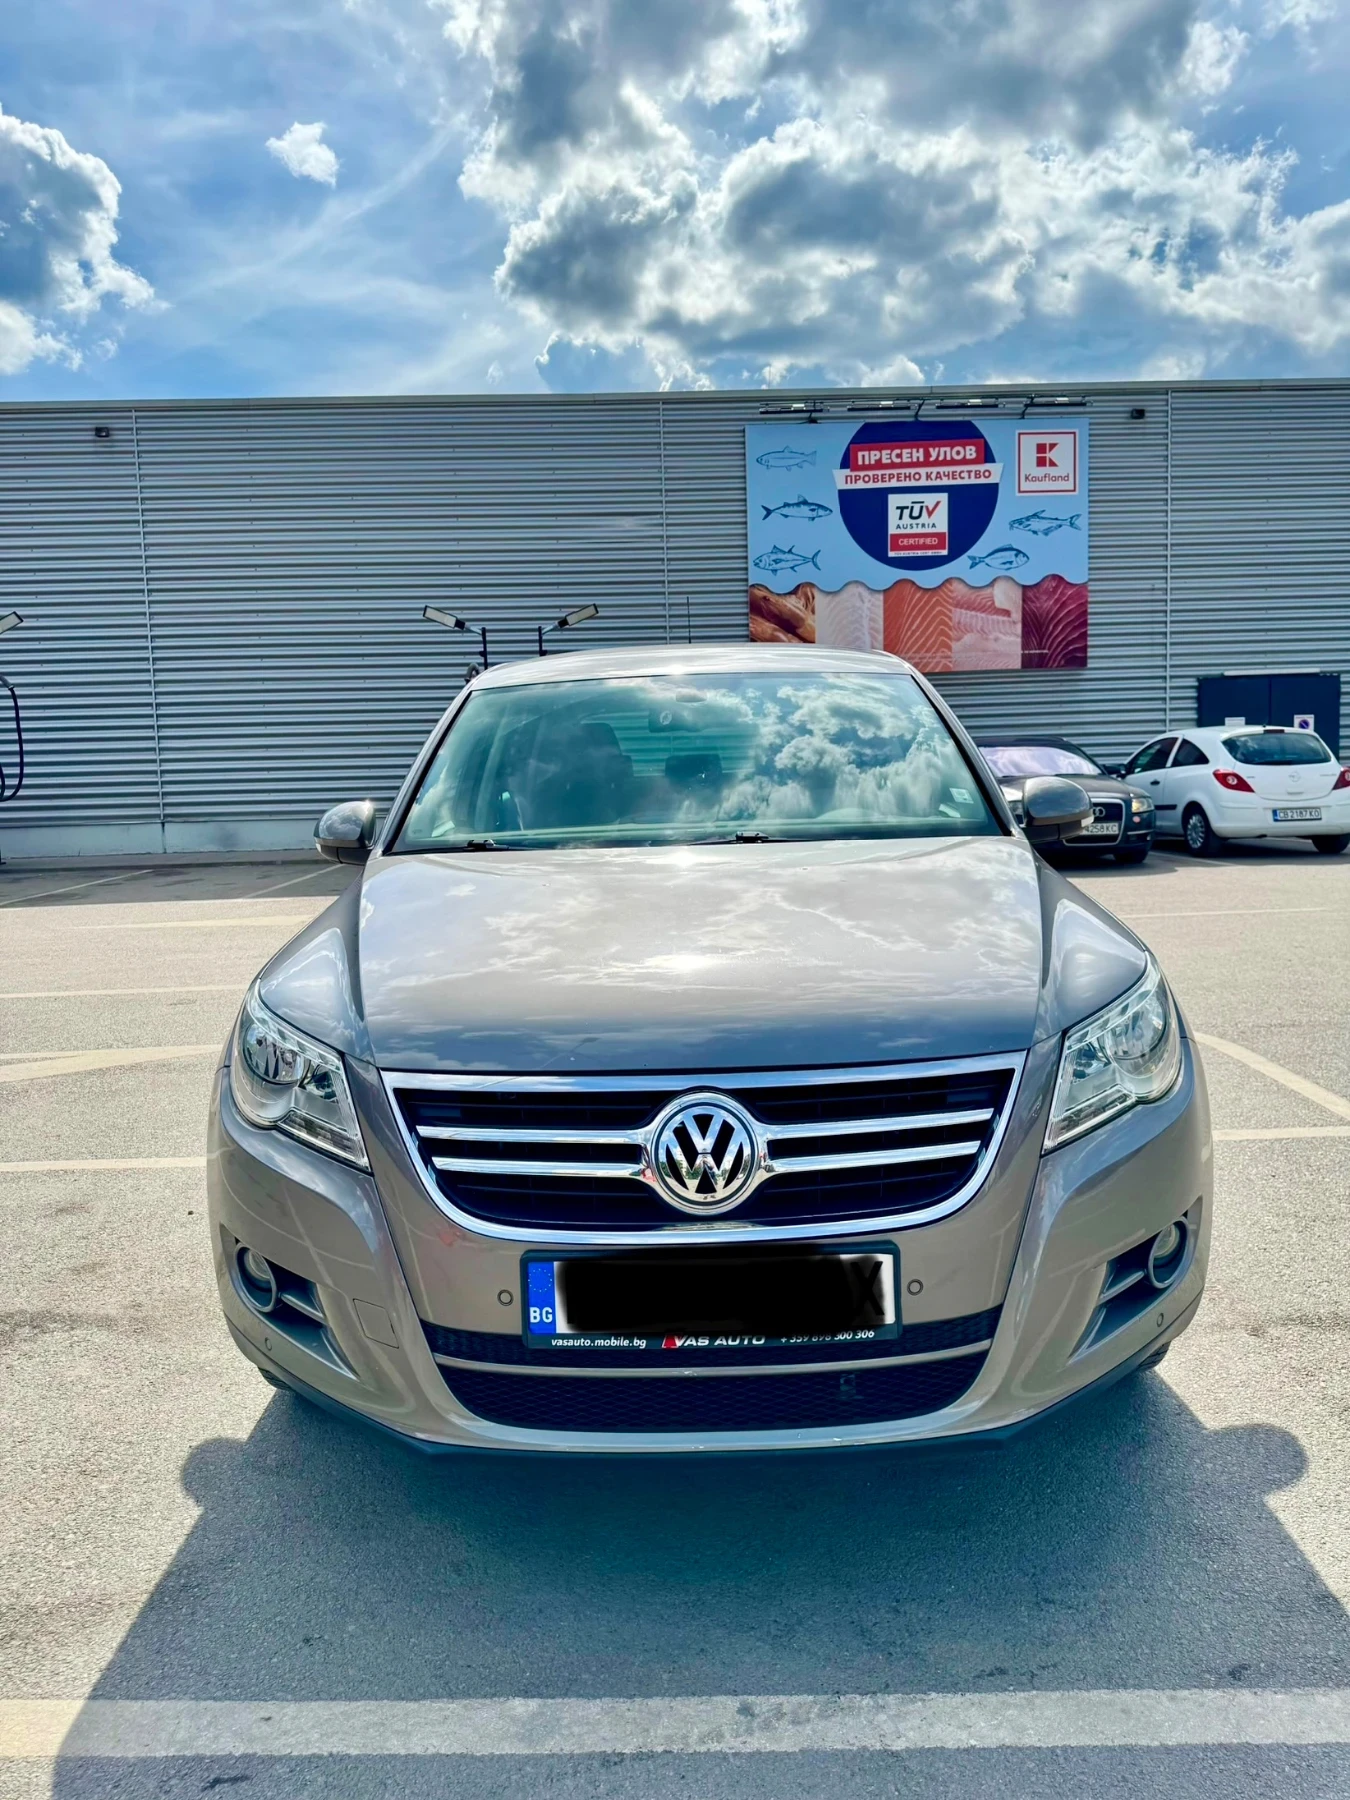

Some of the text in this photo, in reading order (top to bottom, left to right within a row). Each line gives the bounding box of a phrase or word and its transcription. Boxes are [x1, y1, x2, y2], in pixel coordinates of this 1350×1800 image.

[857, 445, 977, 465] ПРЕСЕН УЛОВ
[845, 469, 992, 485] ПРОВЕРЕНО КАЧЕСТВО
[1024, 473, 1070, 483] Kaufland
[898, 538, 939, 546] CERTIFIED
[529, 1307, 553, 1323] BG
[855, 1329, 875, 1339] 306
[551, 1336, 647, 1349] vasauto.mobile.bg
[674, 1335, 766, 1346] VAS AUTO
